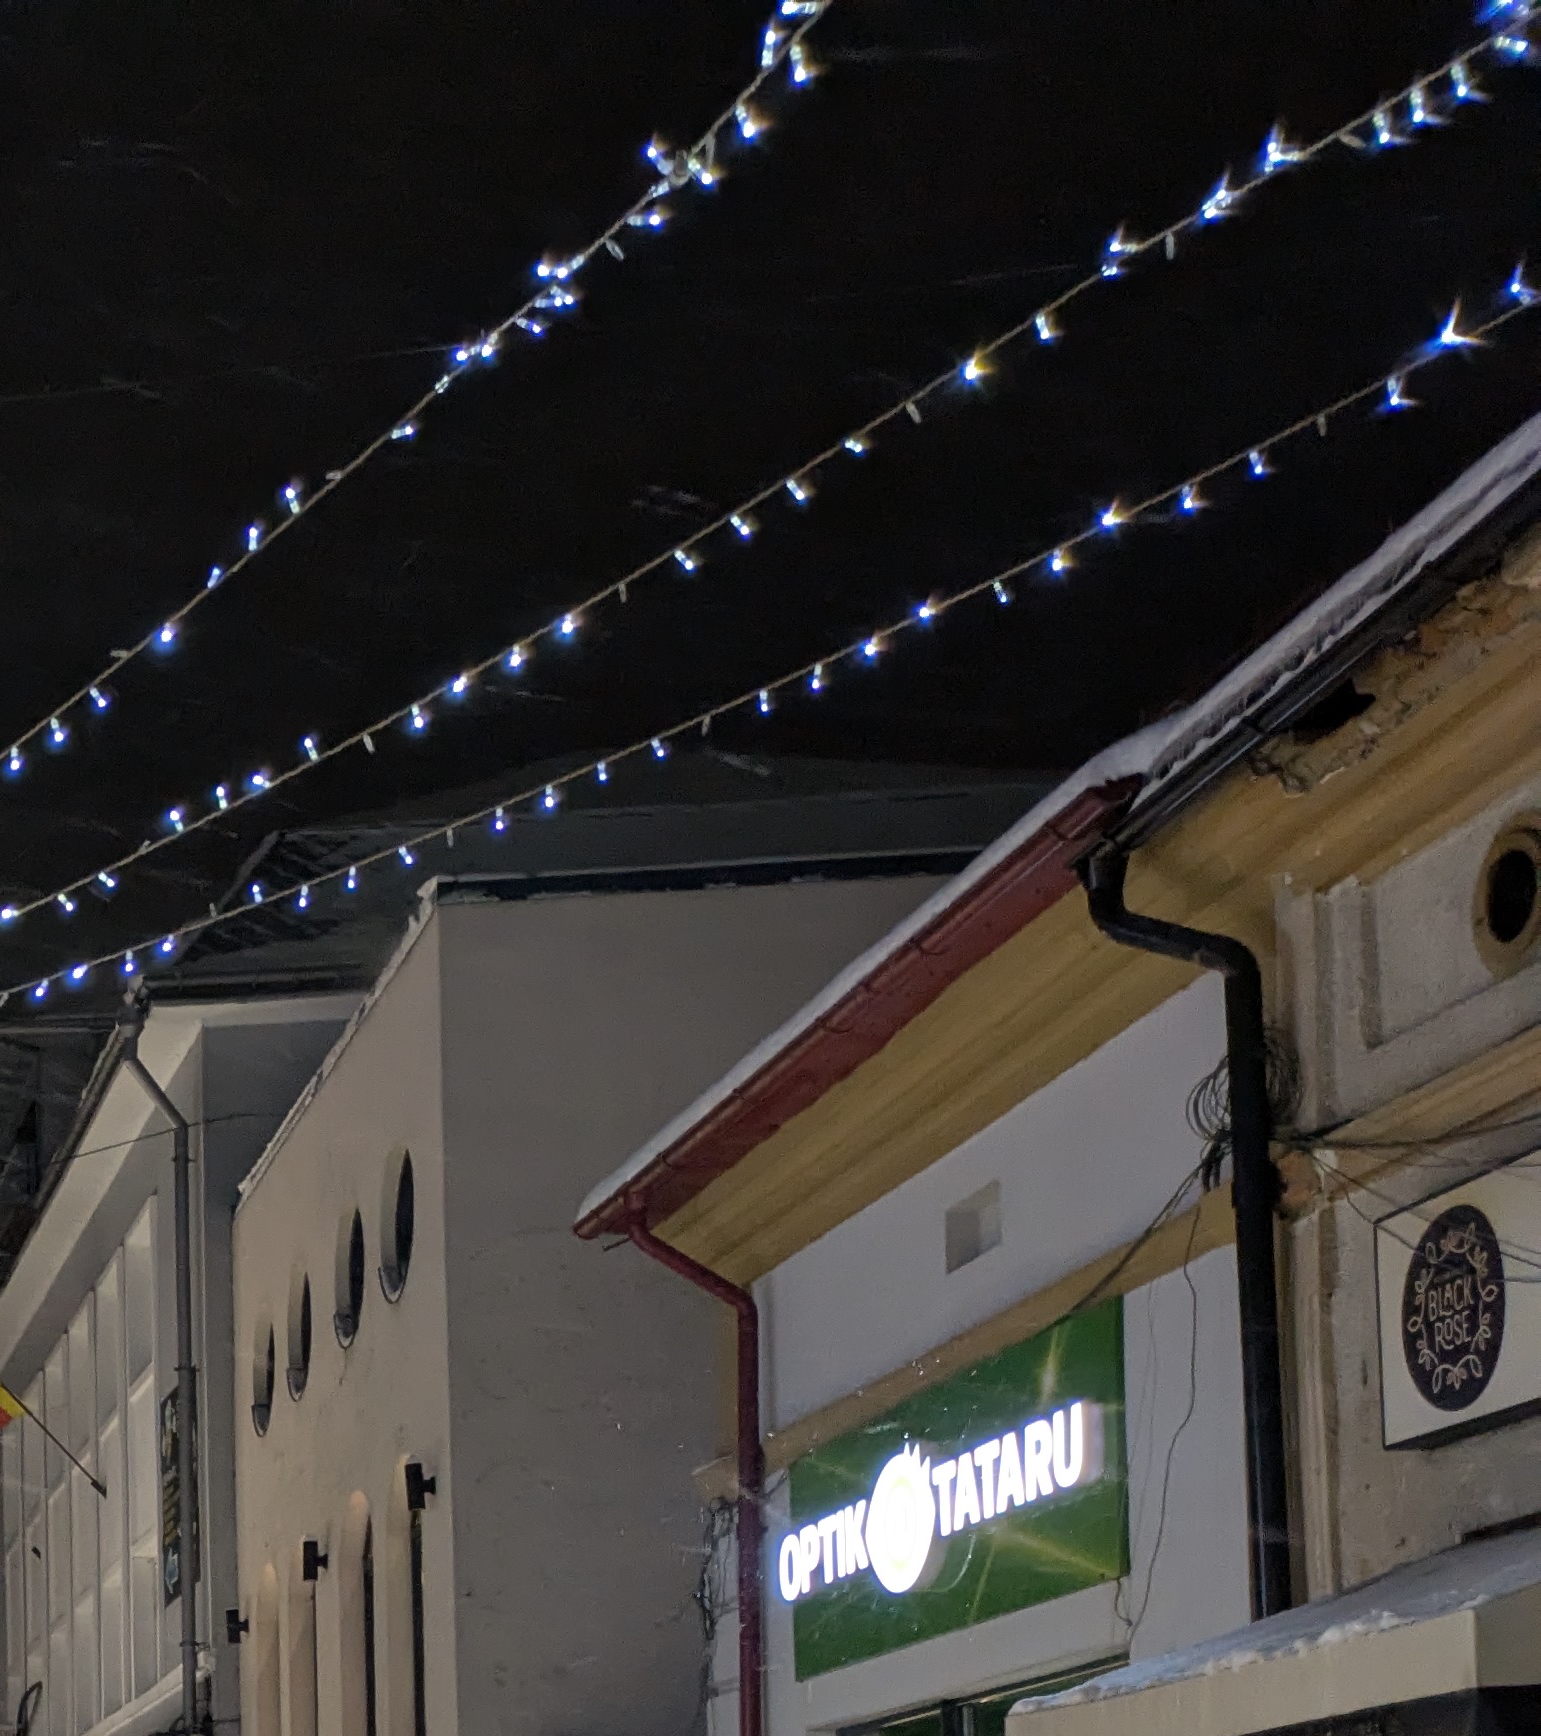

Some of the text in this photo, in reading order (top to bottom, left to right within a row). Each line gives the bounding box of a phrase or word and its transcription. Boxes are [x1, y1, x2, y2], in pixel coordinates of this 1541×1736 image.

[1427, 1276, 1475, 1323] BLACK
[1434, 1310, 1473, 1353] ROSE
[932, 1401, 1084, 1538] TATARU
